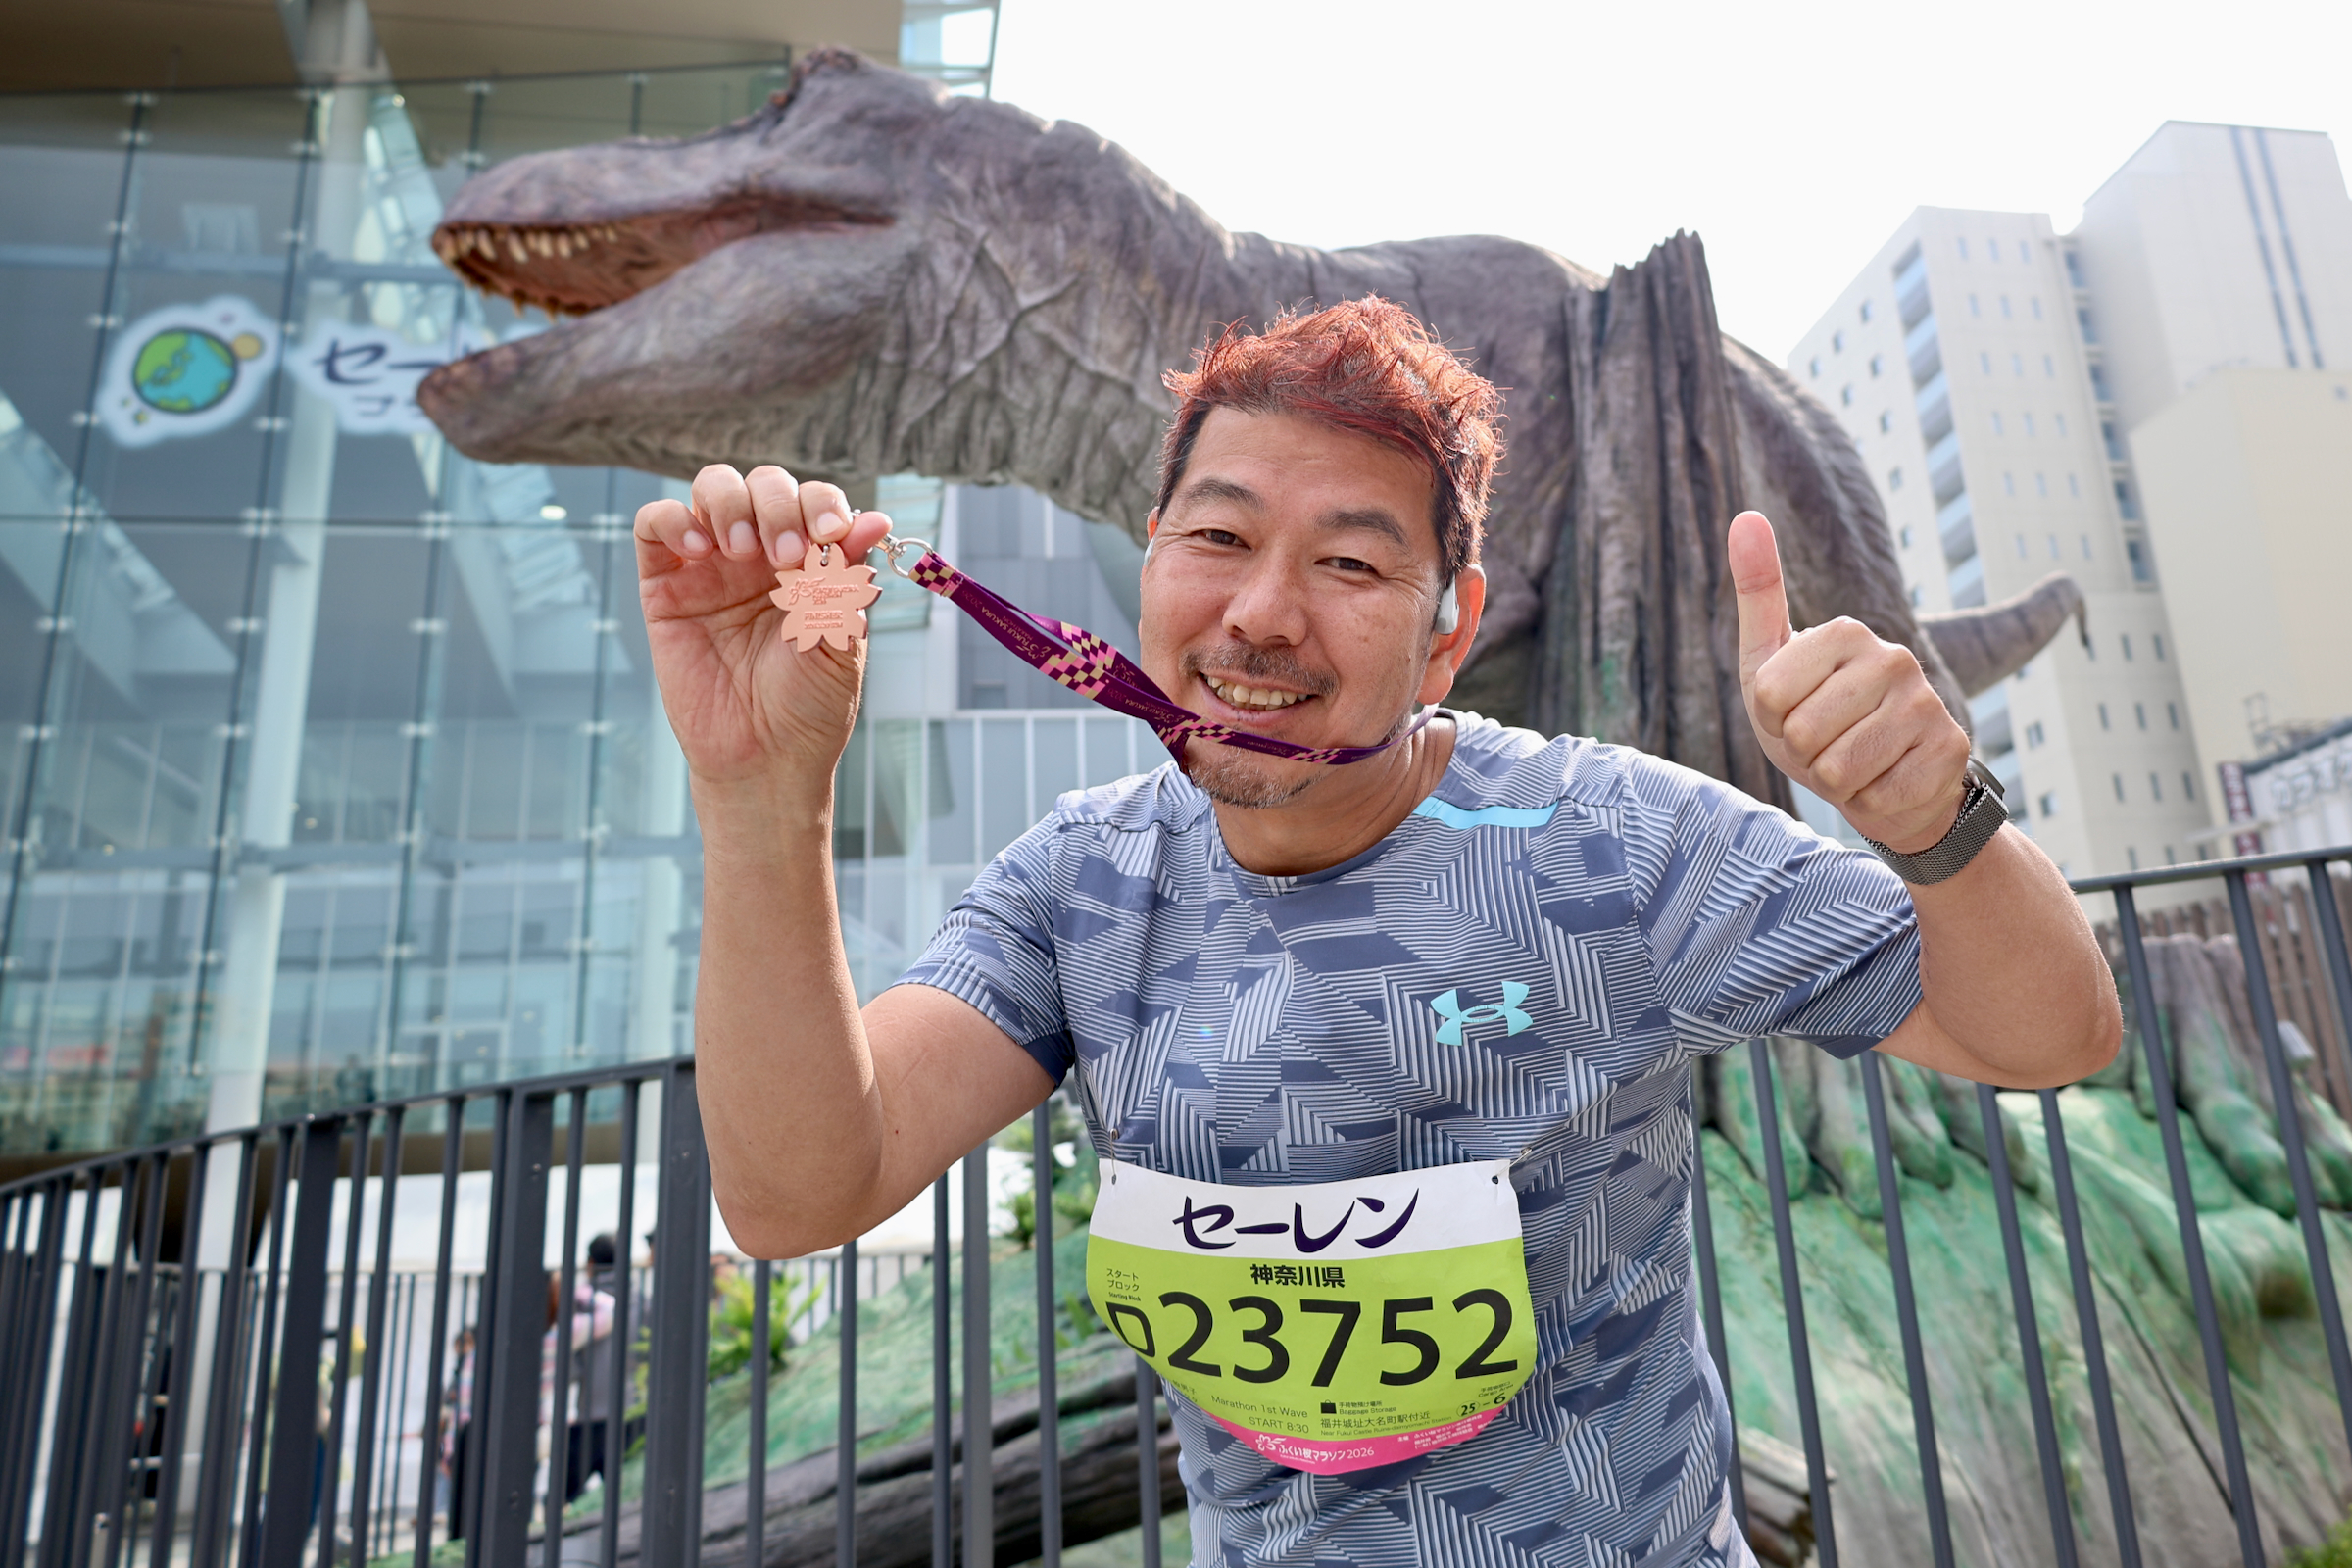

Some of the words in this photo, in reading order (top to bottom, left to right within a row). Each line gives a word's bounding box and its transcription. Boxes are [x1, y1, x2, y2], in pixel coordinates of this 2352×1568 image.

[982, 607, 1008, 631] SAKURA
[1007, 628, 1029, 646] FUKUI
[1172, 1188, 1420, 1253] セーレン
[1106, 1267, 1139, 1282] スタート
[1250, 1264, 1346, 1289] 神奈川県
[1107, 1279, 1140, 1292] ブロック
[1108, 1291, 1128, 1301] Starting
[1128, 1294, 1142, 1302] Block
[1158, 1288, 1518, 1388] 23752
[1478, 1389, 1498, 1398] Cargo
[1498, 1383, 1515, 1393] Area
[1211, 1395, 1258, 1413] Marathon
[1260, 1404, 1277, 1415] 1st
[1279, 1407, 1308, 1419] Wave
[1339, 1407, 1369, 1416] Baggage
[1370, 1405, 1397, 1415] Storage
[1249, 1416, 1284, 1430] START
[1287, 1422, 1309, 1435] 8:30
[1320, 1411, 1431, 1430] 福井城址大名町駅付近
